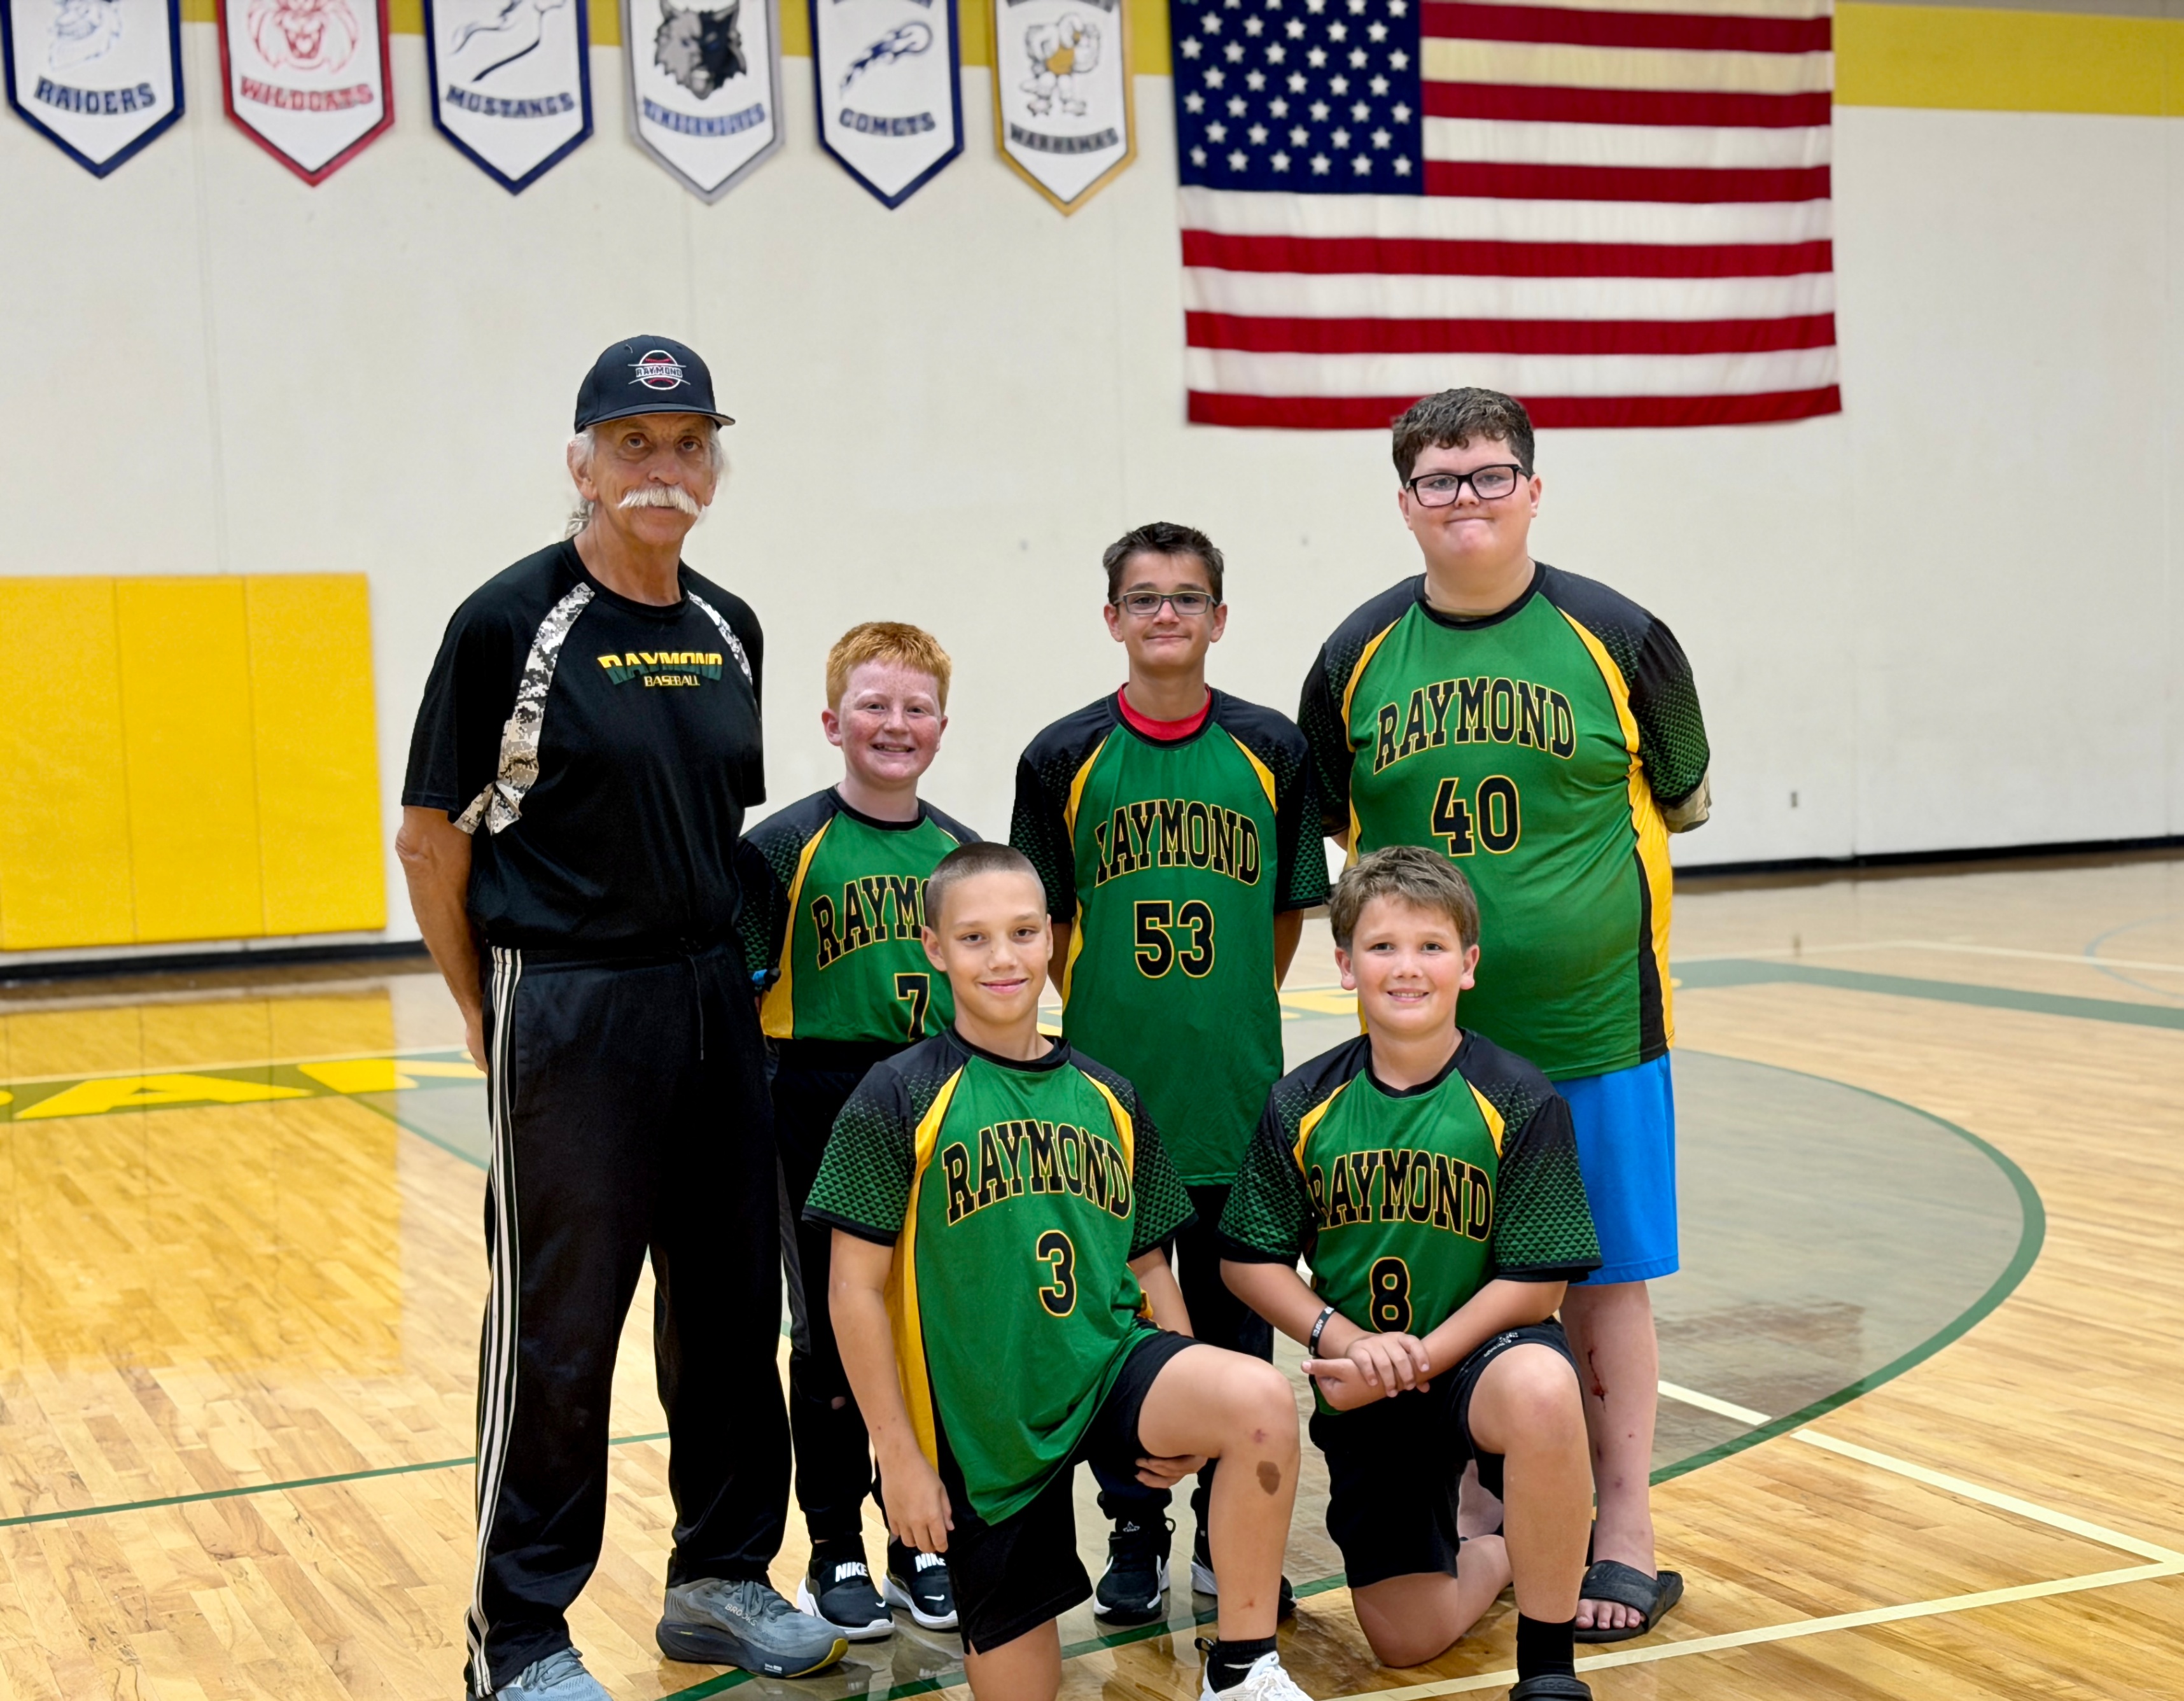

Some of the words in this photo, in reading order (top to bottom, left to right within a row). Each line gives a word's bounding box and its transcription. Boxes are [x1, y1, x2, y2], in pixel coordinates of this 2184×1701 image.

[34, 76, 156, 115] RAIDERS
[241, 75, 374, 111] WILDCATS
[445, 85, 575, 118] MUSTANGS
[839, 108, 936, 137] COMETS
[636, 365, 683, 378] RAYMOND
[597, 652, 723, 685] RAYMOND
[644, 675, 701, 687] BASEBALL
[1373, 676, 1576, 775] RAYMOND
[1431, 775, 1520, 857] 40
[811, 874, 930, 970] RAYM
[1134, 900, 1214, 978] 53
[894, 973, 929, 1042] 7
[942, 1119, 1132, 1227] RAYMOND
[1036, 1229, 1077, 1317] 3
[1369, 1257, 1412, 1334] 8
[835, 1561, 869, 1583] NIKE
[914, 1553, 946, 1572] NIKE
[725, 1603, 758, 1627] BROOKS
